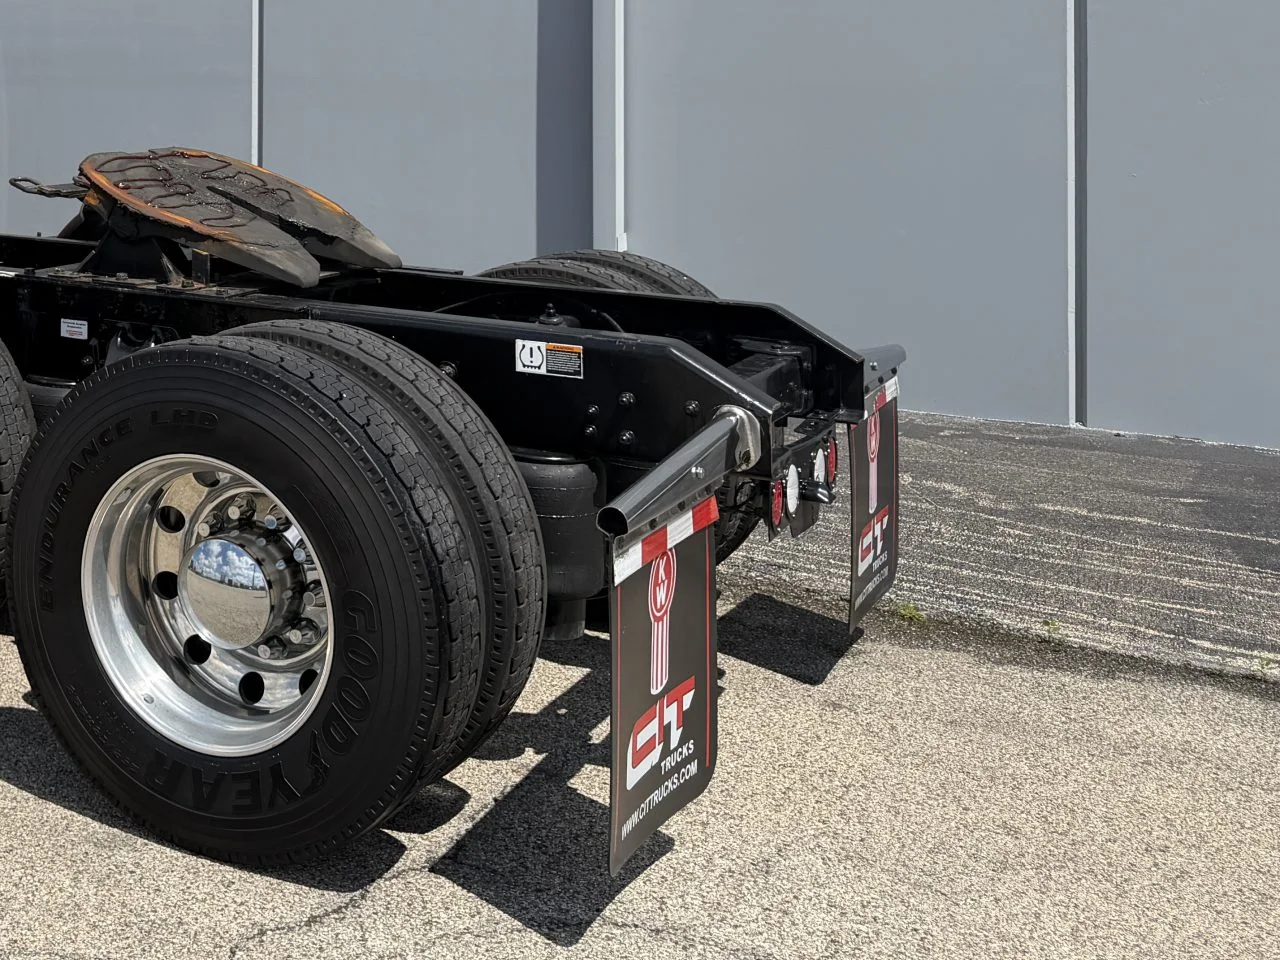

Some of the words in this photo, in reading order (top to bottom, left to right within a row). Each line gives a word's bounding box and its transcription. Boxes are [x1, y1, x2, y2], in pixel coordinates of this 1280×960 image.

[39, 417, 134, 614] ENDURANCE
[149, 408, 220, 432] LHD
[142, 589, 381, 817] GOODYEAR
[627, 675, 696, 791] CIT
[660, 740, 695, 776] TRUCKS
[621, 758, 698, 841] WWW.CITTRUCKS.COM
